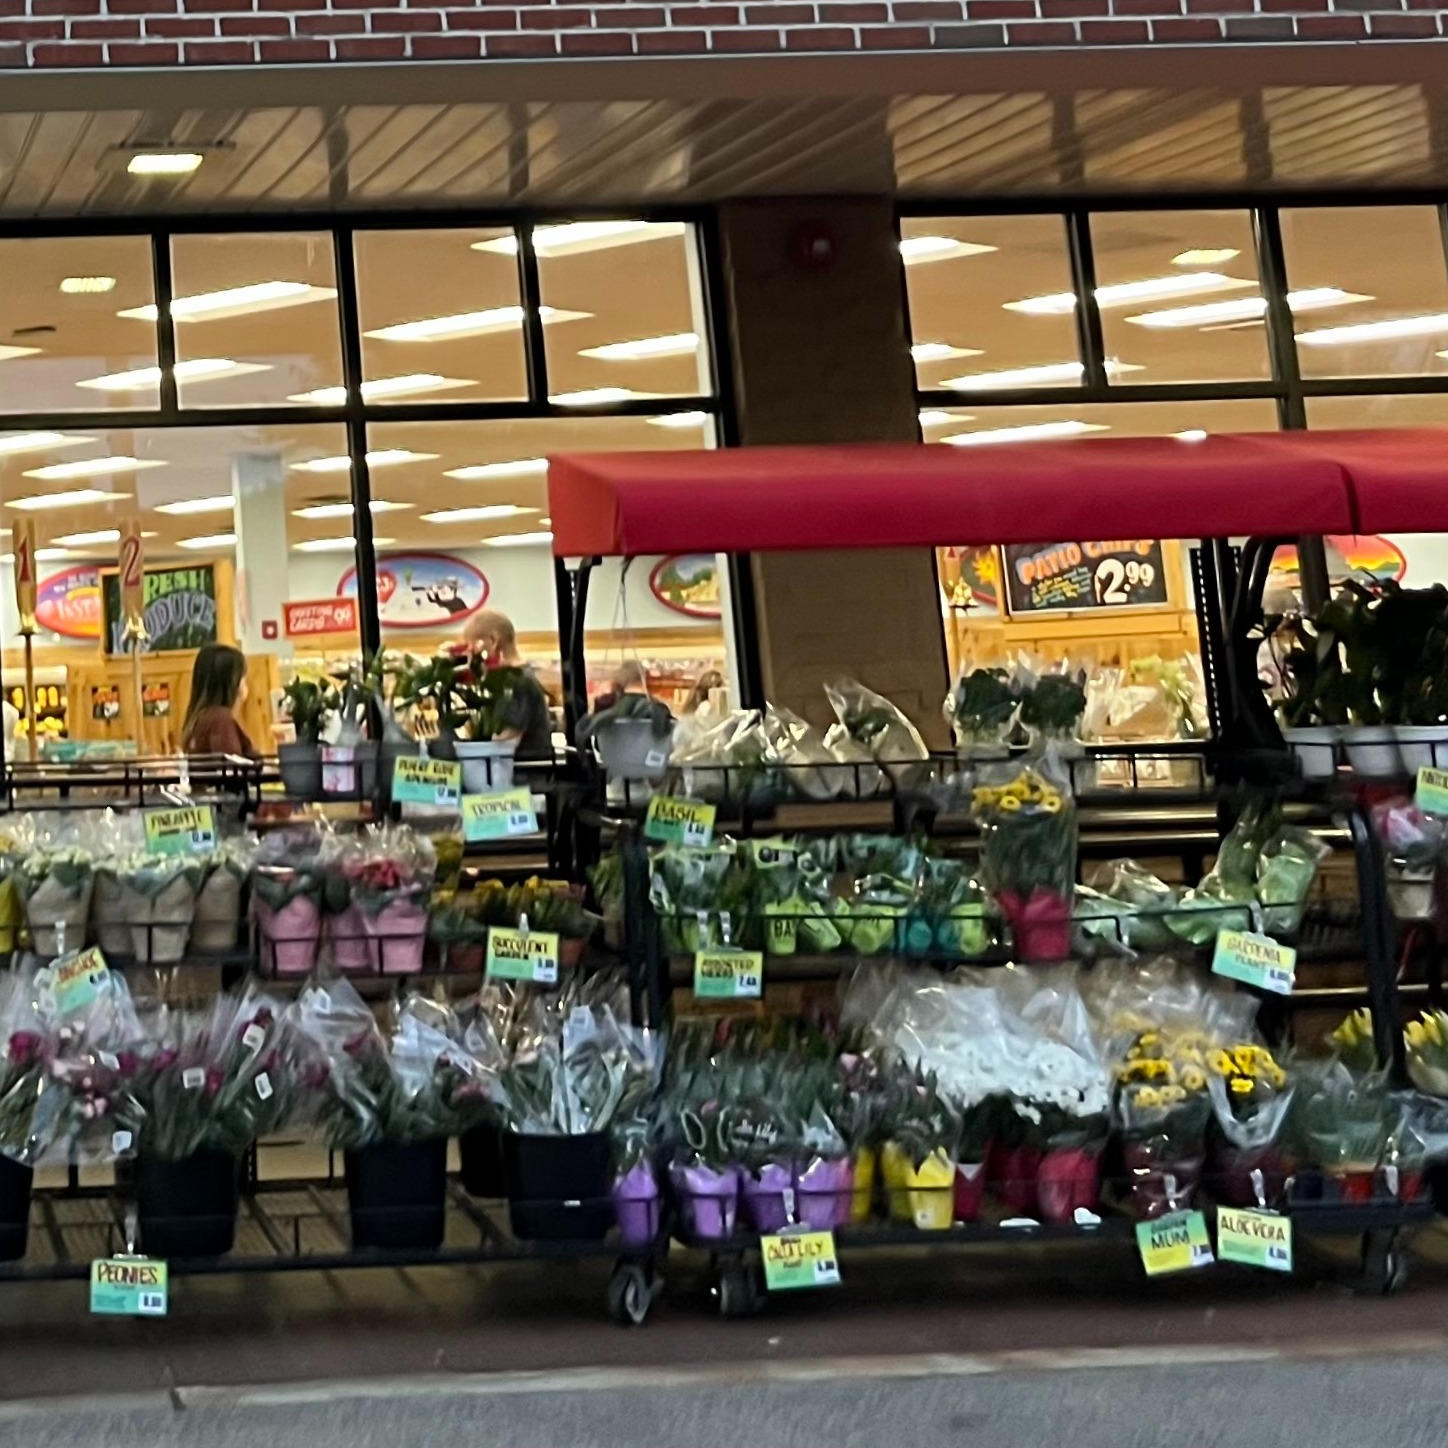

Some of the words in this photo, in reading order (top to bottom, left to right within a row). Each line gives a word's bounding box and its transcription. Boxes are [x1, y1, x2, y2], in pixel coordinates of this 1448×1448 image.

[122, 535, 143, 587] 2
[1015, 542, 1082, 585] PATIO
[144, 566, 207, 602] RESH
[1095, 558, 1155, 604] 2.99
[654, 800, 702, 823] BASIL
[1226, 936, 1281, 963] GARDENIA
[1150, 1229, 1190, 1250] MUM
[1220, 1215, 1251, 1235] ALOE
[1253, 1221, 1286, 1241] VERA
[97, 1261, 158, 1285] PEONIES
